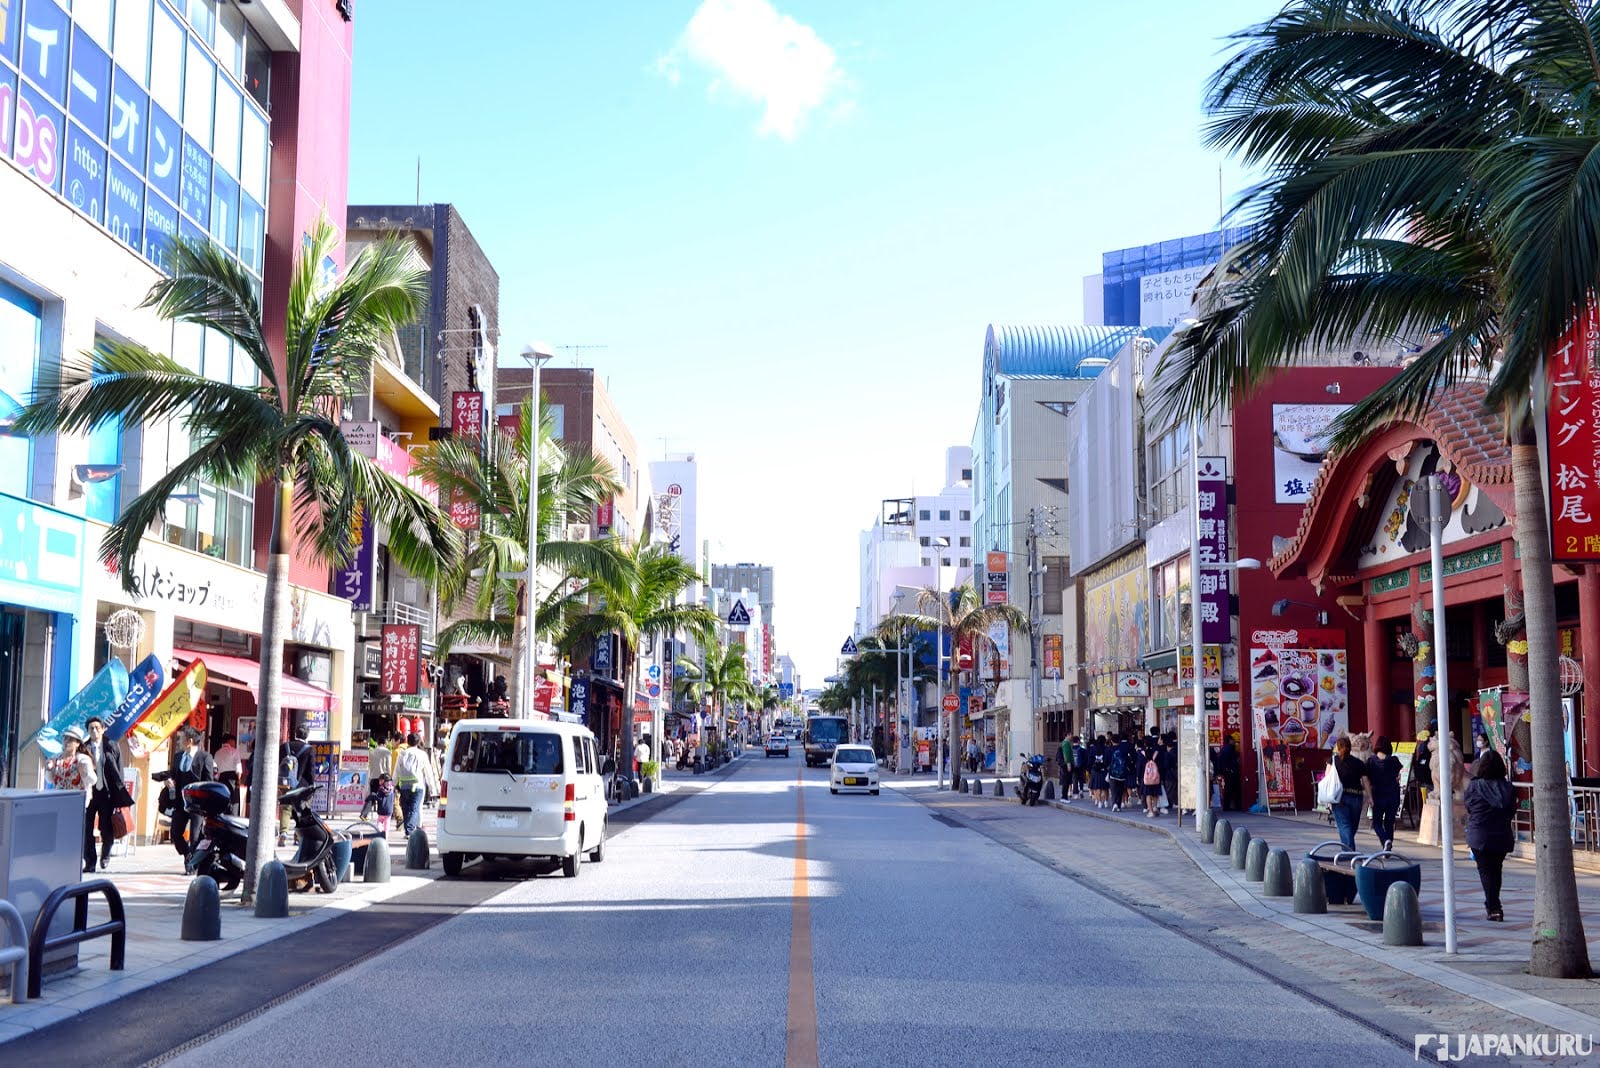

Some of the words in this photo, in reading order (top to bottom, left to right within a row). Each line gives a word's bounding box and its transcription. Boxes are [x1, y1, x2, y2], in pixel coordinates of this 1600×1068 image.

[27, 22, 174, 178] イーオン
[1144, 271, 1201, 289] 子どもたちに
[1552, 304, 1585, 447] イニング
[466, 395, 480, 450] 石垣牛
[1555, 463, 1592, 524] 松尾
[1199, 490, 1219, 623] 御菓子御殿
[385, 630, 399, 692] 焼肉パナリ
[365, 703, 399, 711] HEARTS
[572, 683, 586, 715] 泡盛
